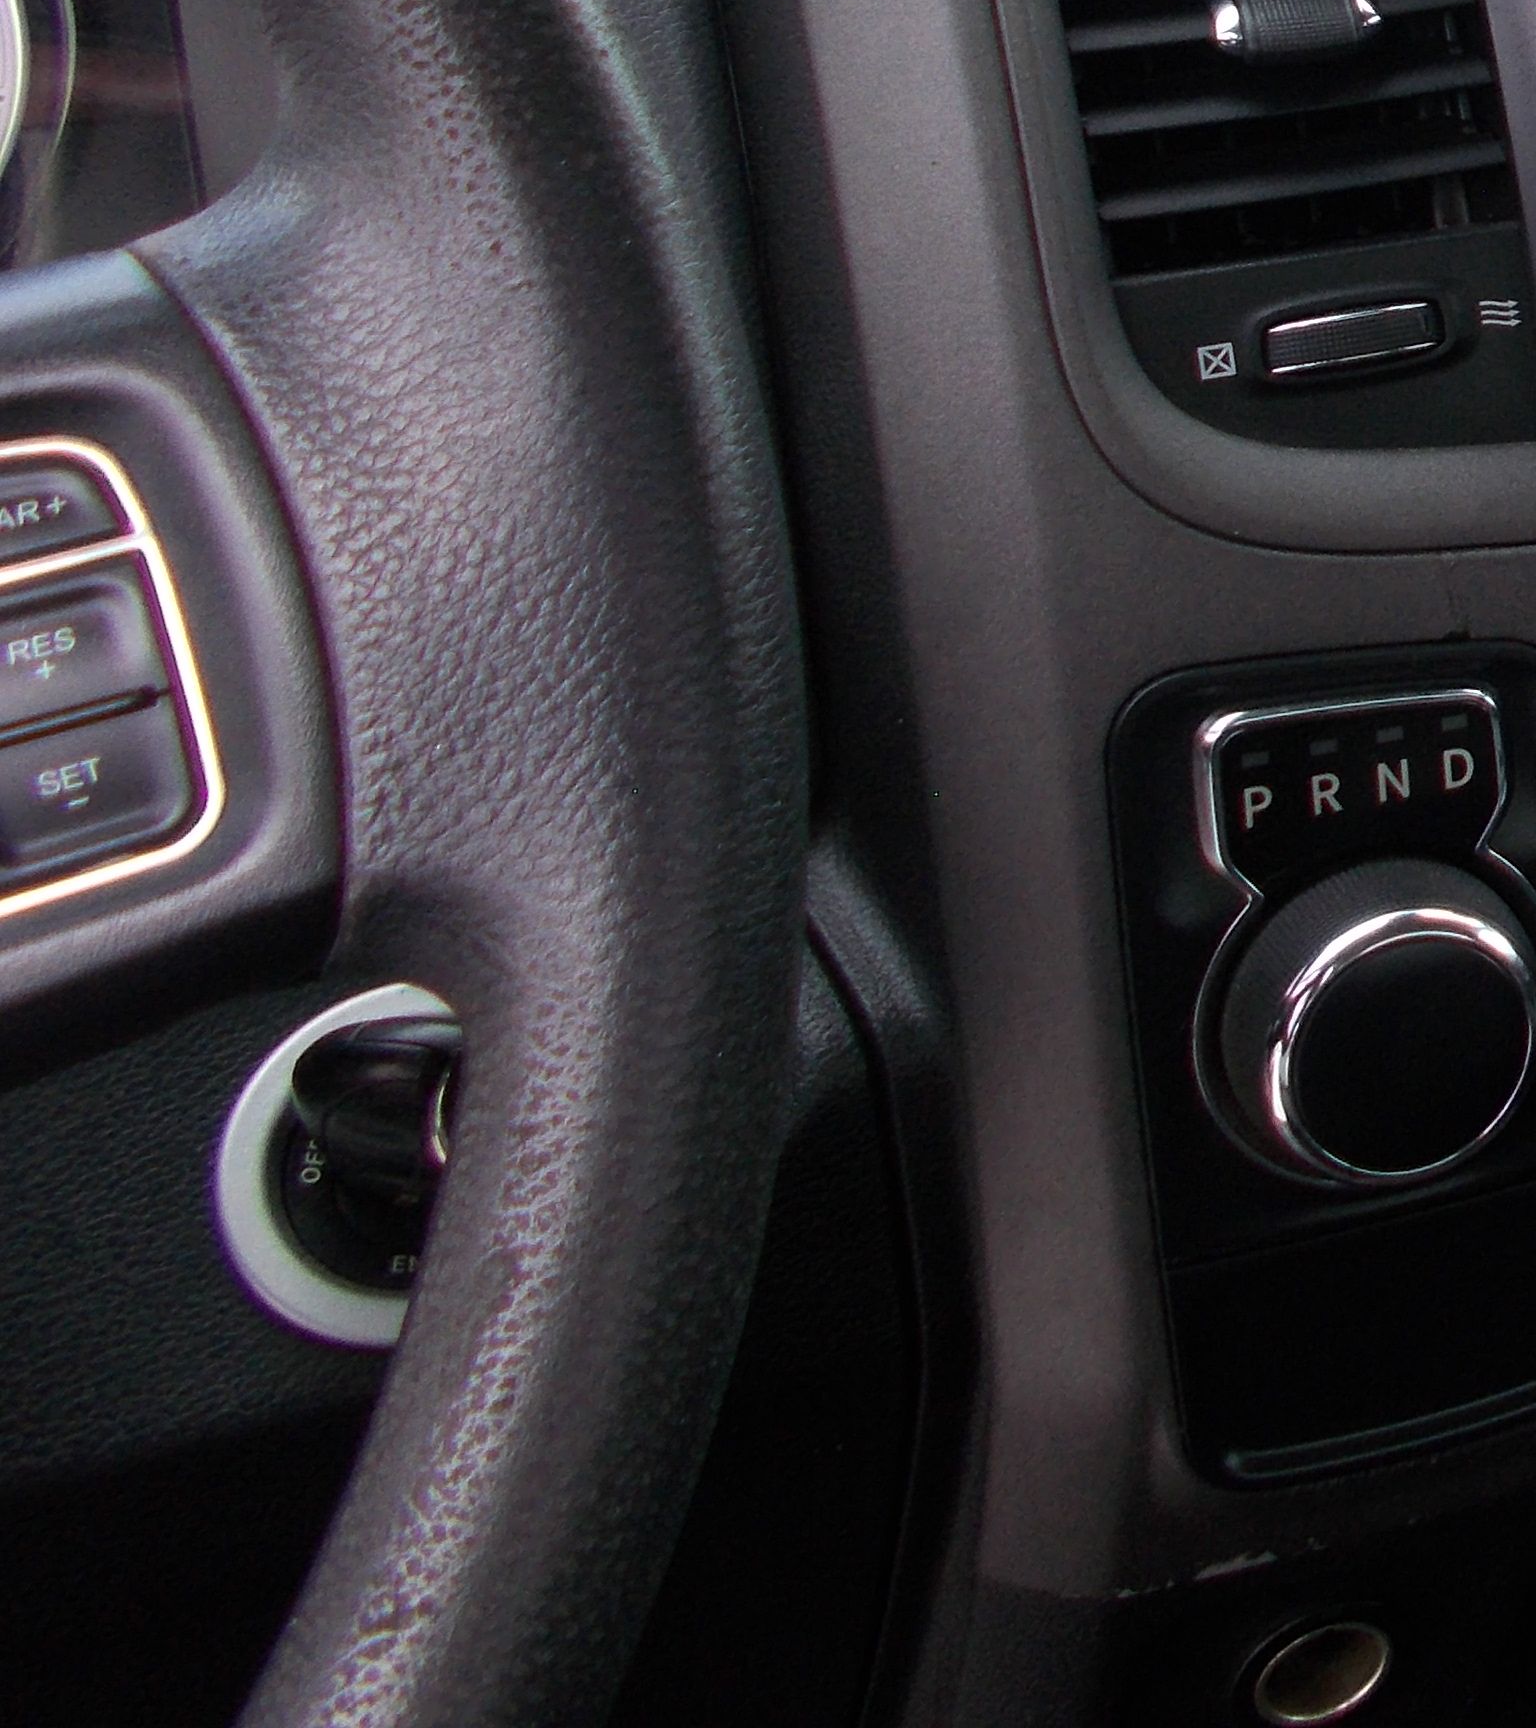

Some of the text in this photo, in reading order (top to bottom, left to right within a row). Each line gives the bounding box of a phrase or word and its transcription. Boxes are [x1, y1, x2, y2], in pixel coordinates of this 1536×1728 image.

[7, 627, 76, 665] RES
[36, 757, 100, 798] SET
[1241, 747, 1475, 830] P R N D
